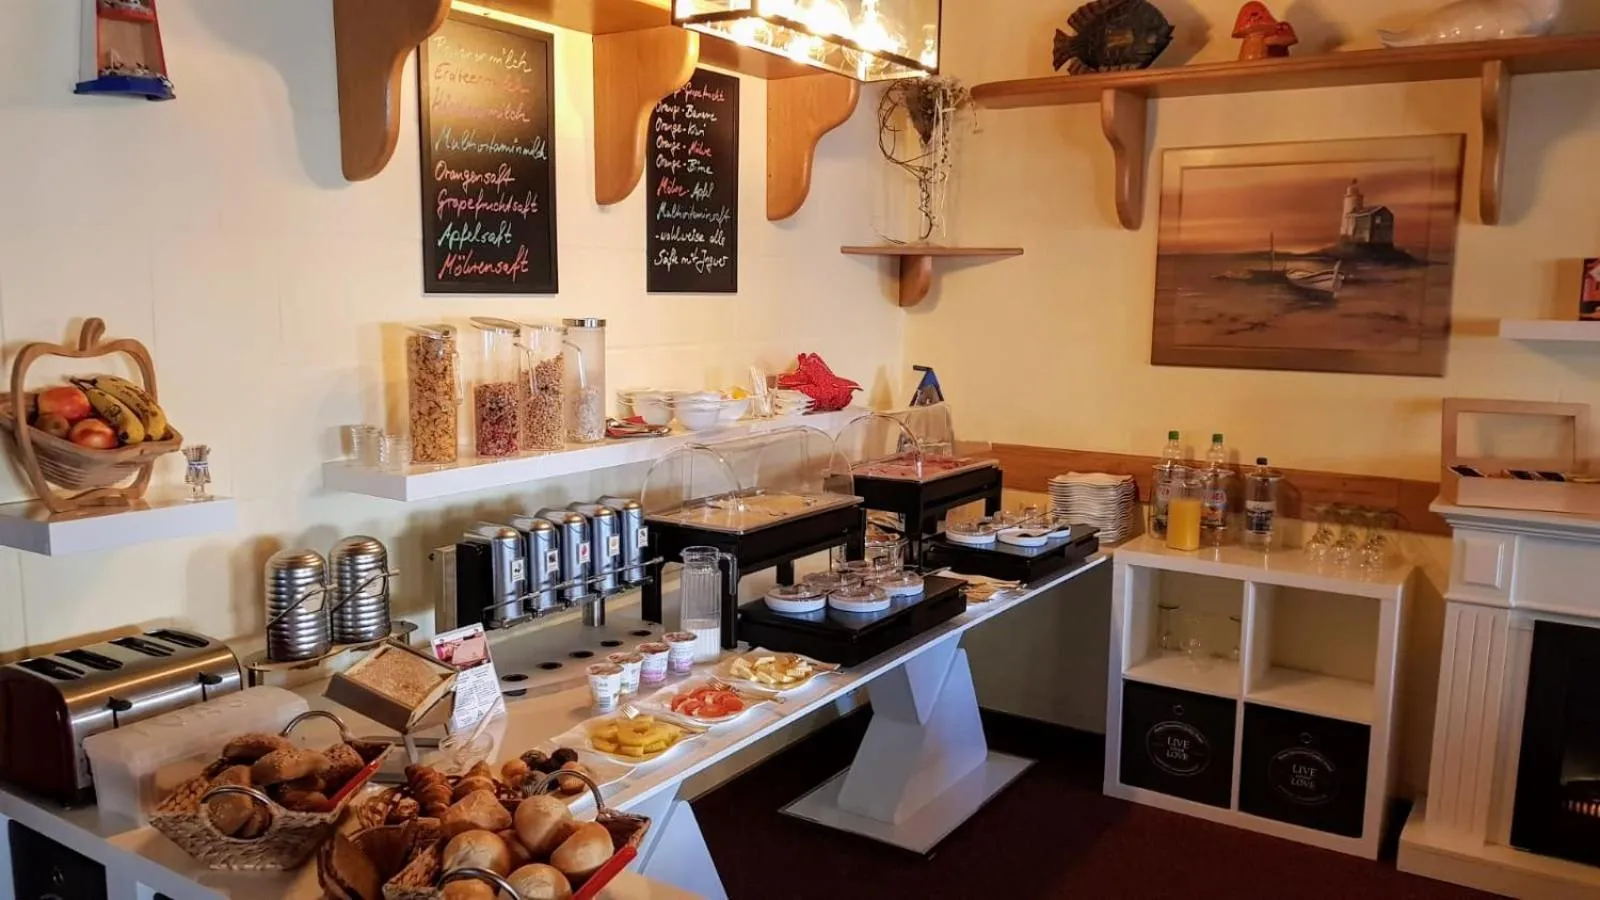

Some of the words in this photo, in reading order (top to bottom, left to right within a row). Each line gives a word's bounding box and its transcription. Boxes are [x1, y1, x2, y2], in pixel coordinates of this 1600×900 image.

[435, 160, 515, 194] Orangensaft
[437, 188, 539, 220] Grapefruchtsaft
[438, 220, 513, 250] Apfelsaft
[438, 244, 529, 283] Möhrensaft
[1167, 736, 1191, 749] LIVE
[1292, 764, 1318, 776] LIVE
